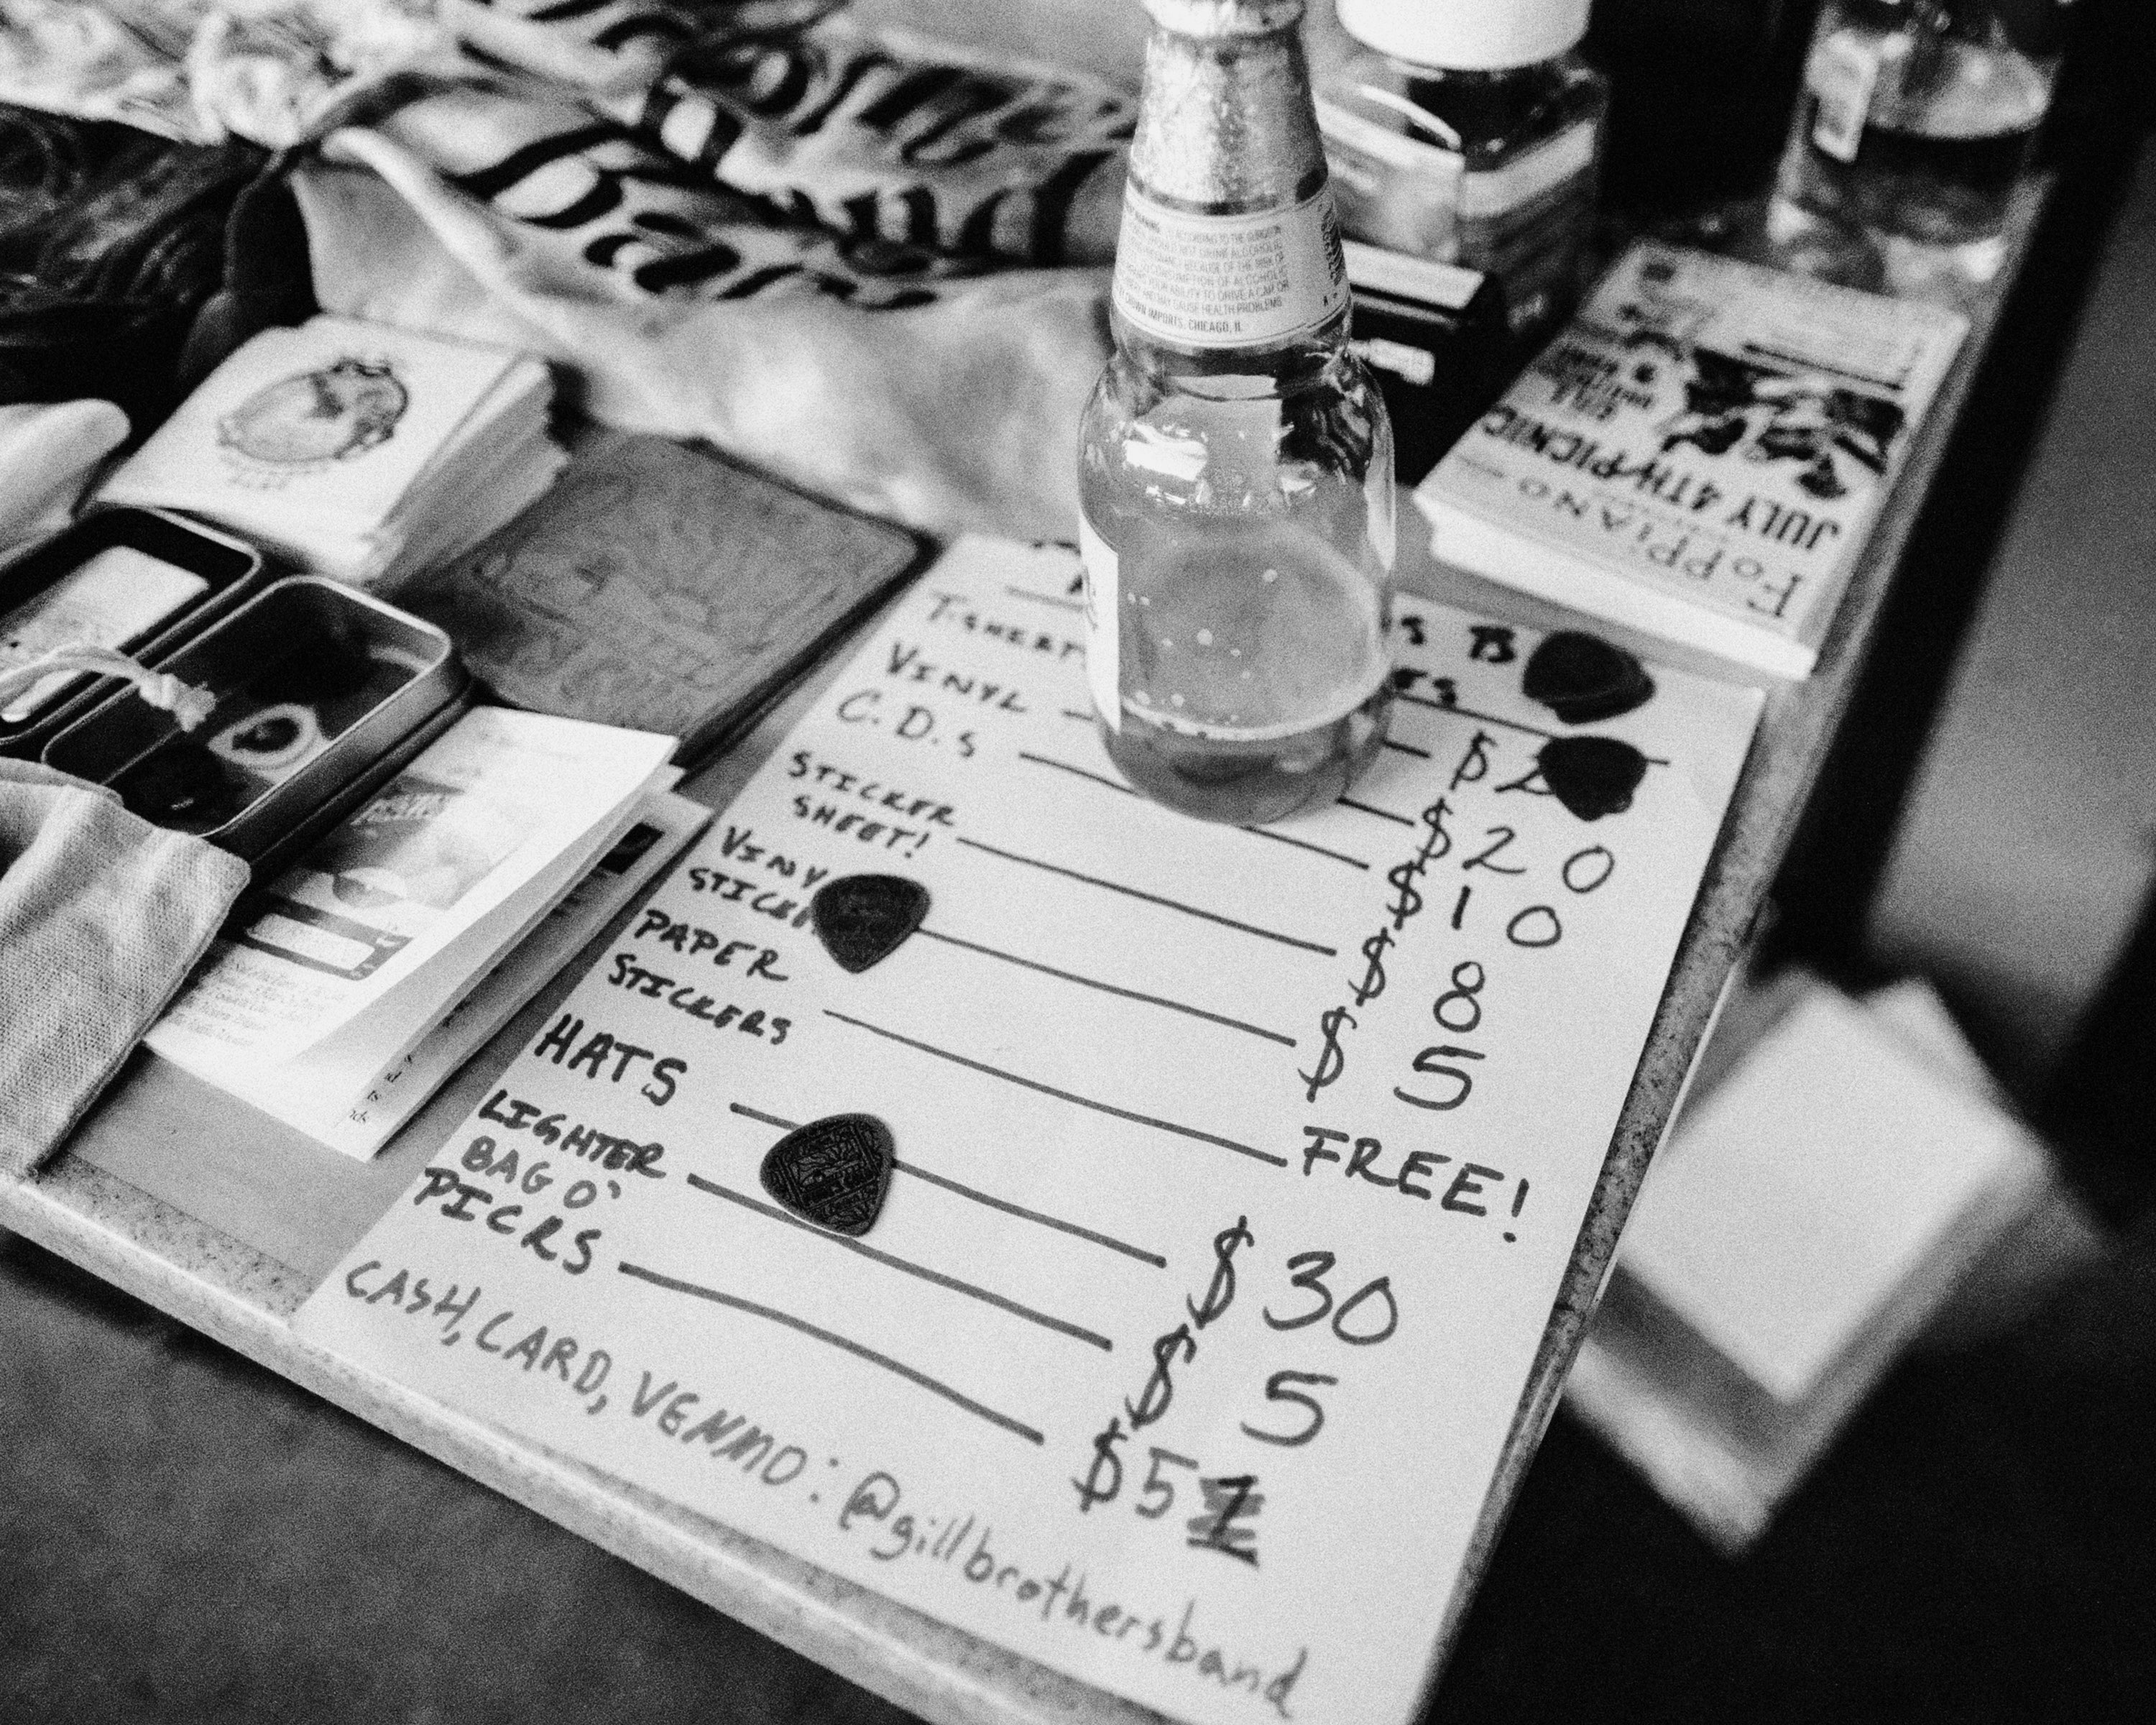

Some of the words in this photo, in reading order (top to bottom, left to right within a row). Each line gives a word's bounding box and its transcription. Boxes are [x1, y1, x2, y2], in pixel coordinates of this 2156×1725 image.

[1636, 460, 1722, 512] 4TH
[1726, 496, 1841, 551] JULY
[887, 642, 1026, 712] VINYL
[789, 750, 955, 827] STICKER
[635, 908, 789, 982] PAPER
[478, 1088, 667, 1179] LIGHTER
[608, 952, 792, 1046] STICKERS
[1302, 1125, 1530, 1243] FREE!
[460, 1134, 553, 1195] BAG
[533, 1013, 688, 1107] HATS
[1186, 1215, 1399, 1346] $30
[413, 1167, 602, 1275] PICKS
[838, 1471, 1309, 1720] @gillbrothersband
